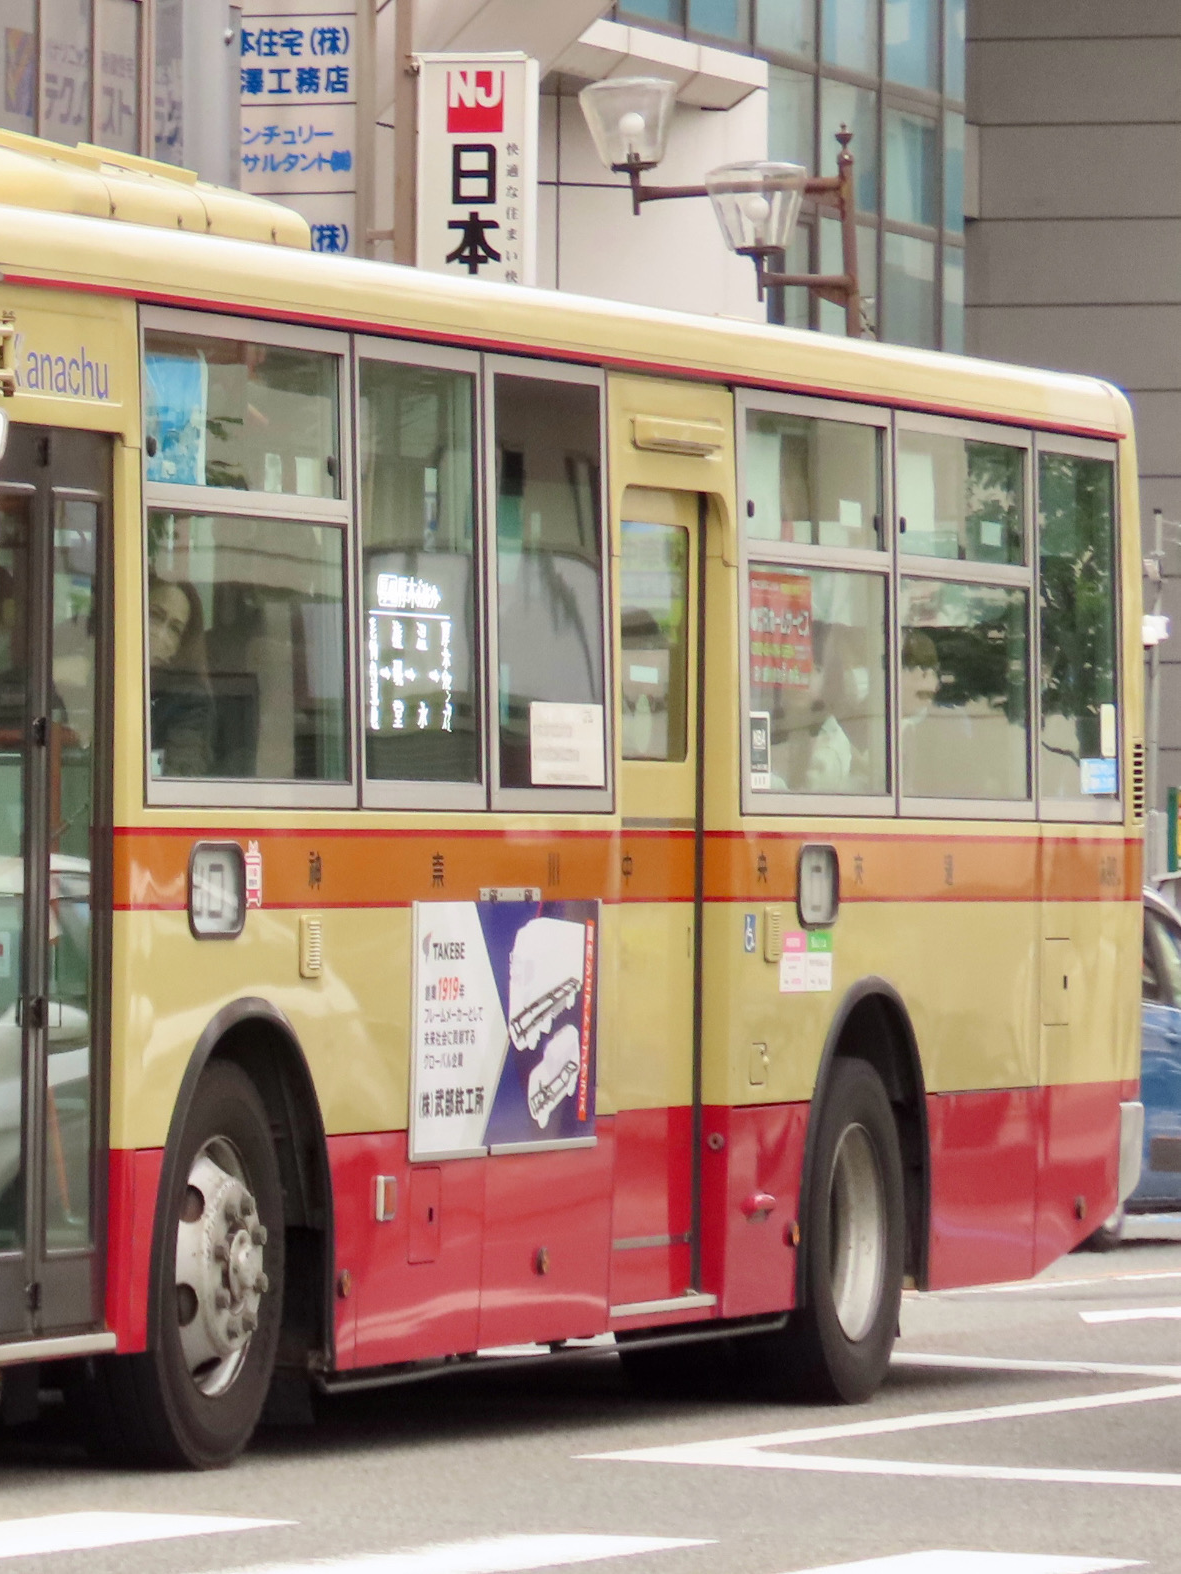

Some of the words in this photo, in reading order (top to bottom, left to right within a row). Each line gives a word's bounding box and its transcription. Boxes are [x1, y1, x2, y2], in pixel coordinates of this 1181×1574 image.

[449, 71, 502, 109] NJ
[446, 144, 501, 274] 日本
[433, 942, 466, 961] TAKEBE
